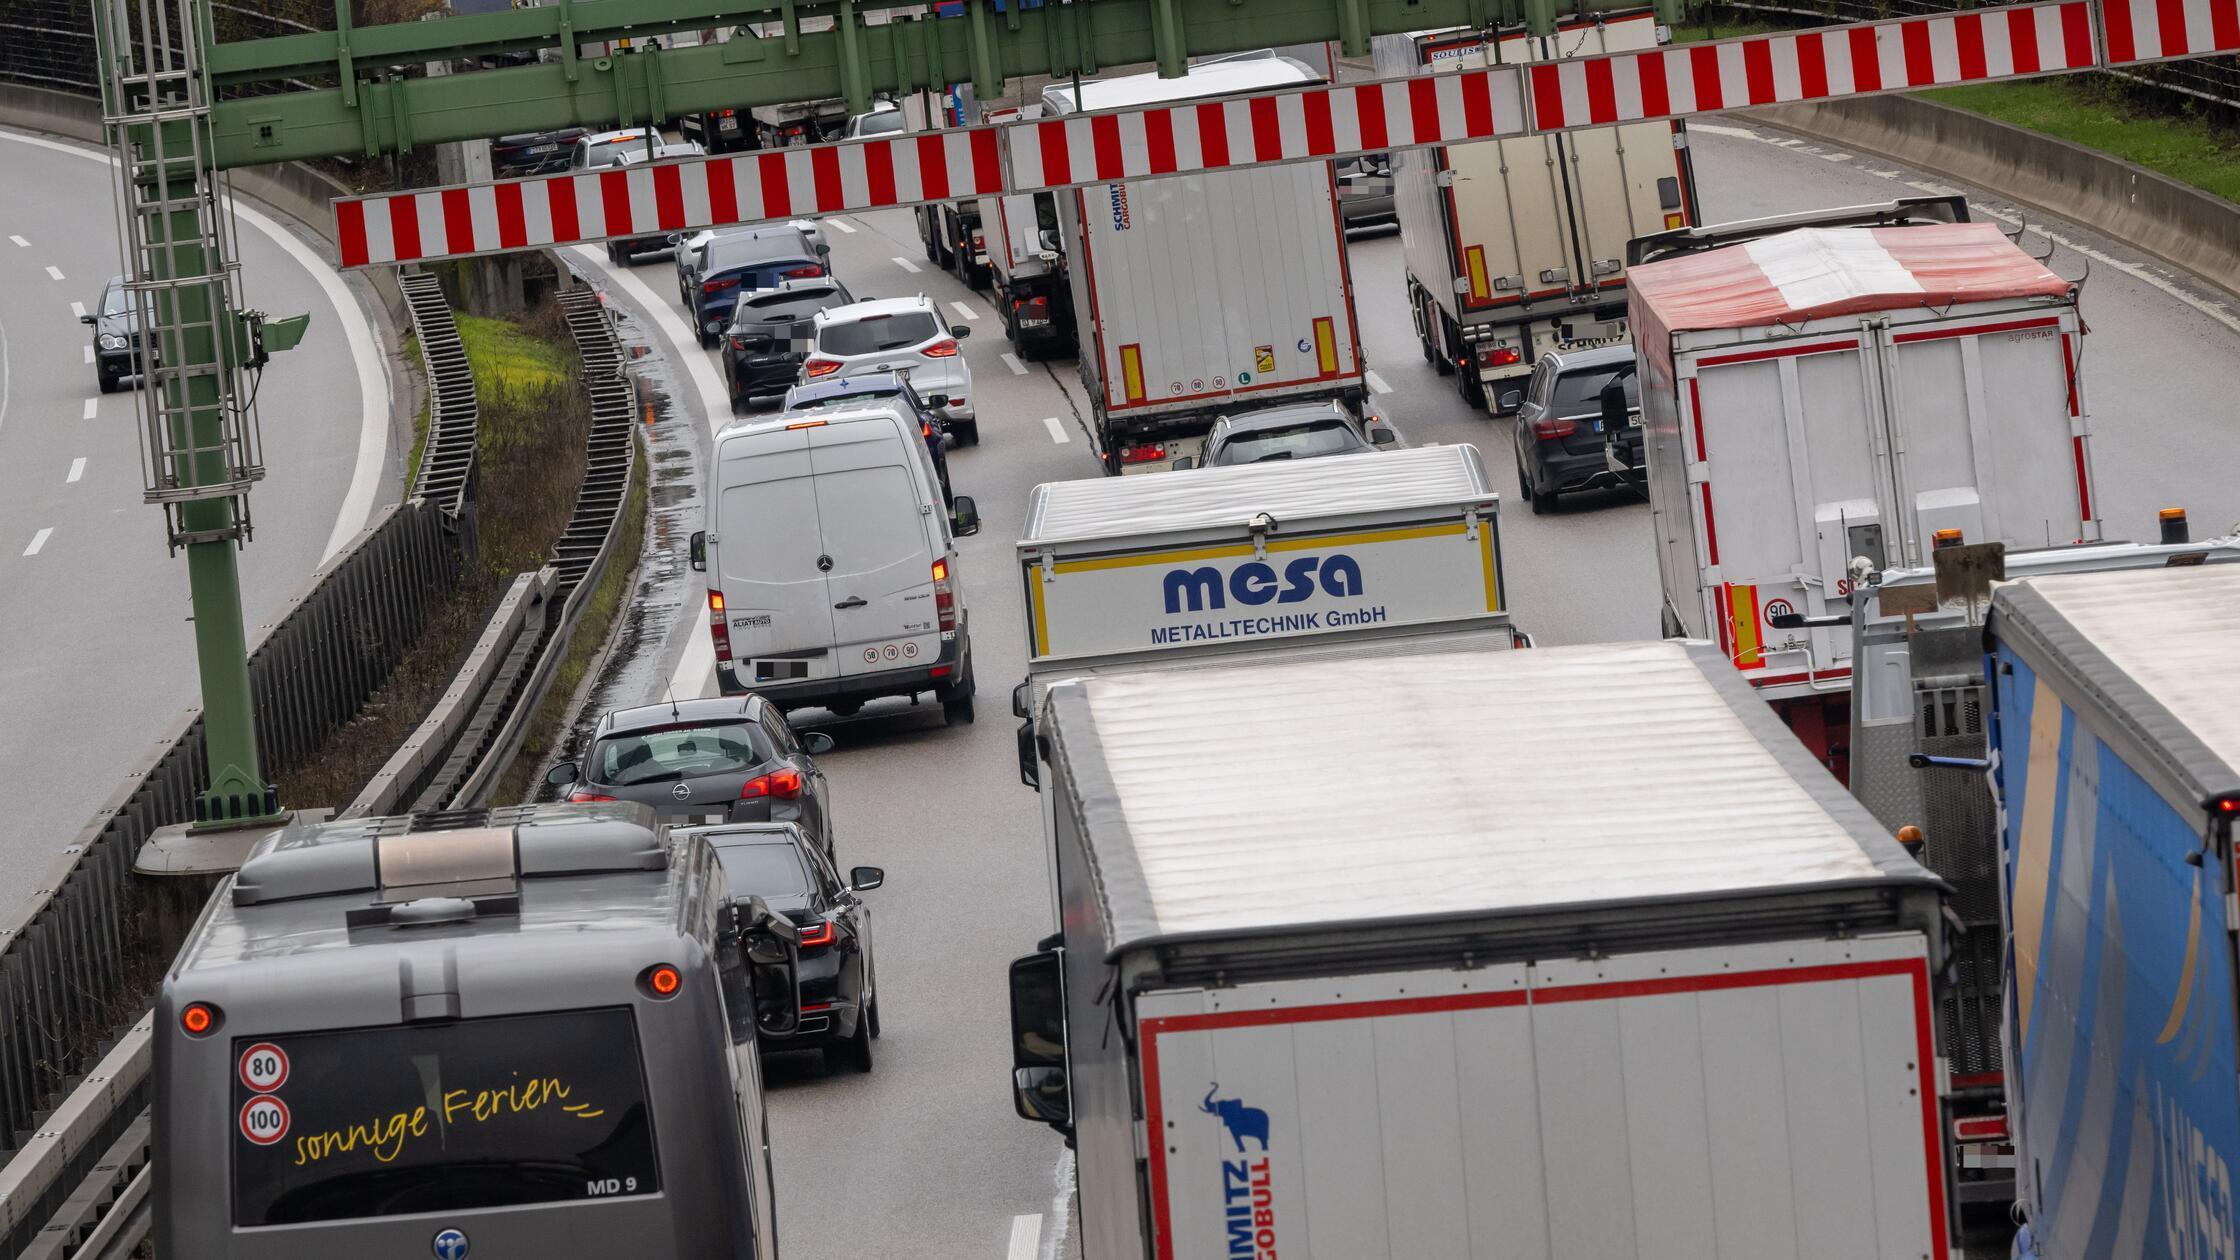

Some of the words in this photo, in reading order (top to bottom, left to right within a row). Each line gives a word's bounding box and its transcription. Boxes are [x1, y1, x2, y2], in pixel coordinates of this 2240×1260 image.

[2008, 330, 2053, 343] agroSTAR
[1163, 554, 1363, 614] mesa
[1151, 612, 1320, 644] METALLTECHNIK
[1326, 605, 1386, 627] GmbH
[867, 651, 875, 659] 50
[887, 648, 895, 656] 70
[906, 646, 914, 654] 90
[252, 1057, 276, 1077] 80
[249, 1110, 281, 1130] 100
[295, 1106, 428, 1166] sonnige
[443, 1071, 569, 1124] Ferien
[587, 1178, 621, 1196] MD
[625, 1176, 637, 1192] 9
[1222, 1159, 1255, 1260] MITZ
